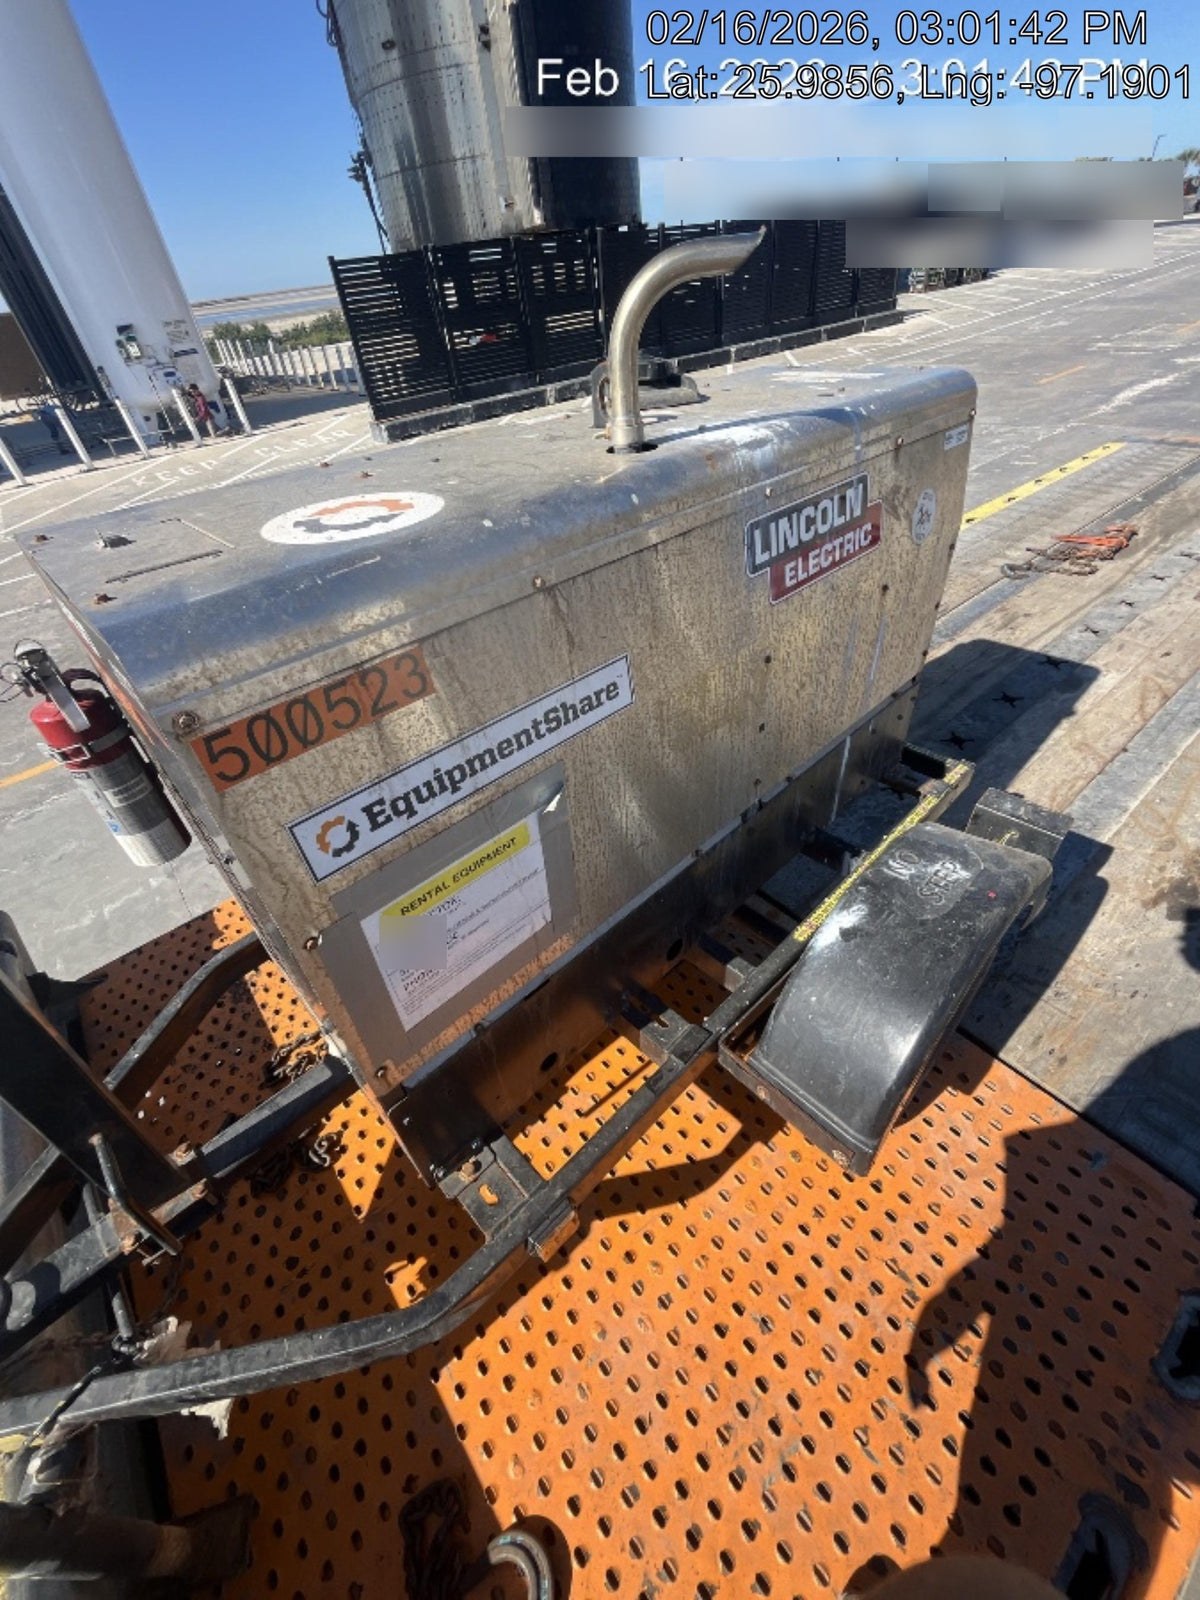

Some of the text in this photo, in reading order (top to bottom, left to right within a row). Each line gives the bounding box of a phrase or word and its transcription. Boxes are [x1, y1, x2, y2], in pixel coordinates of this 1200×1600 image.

[752, 482, 865, 567] LINCOLN
[784, 522, 873, 588] ELECTRIC
[202, 652, 429, 783] 500523
[362, 680, 620, 833] EquipmentShare
[400, 882, 450, 916] RENTAL
[452, 837, 517, 883] EQUIPMENT
